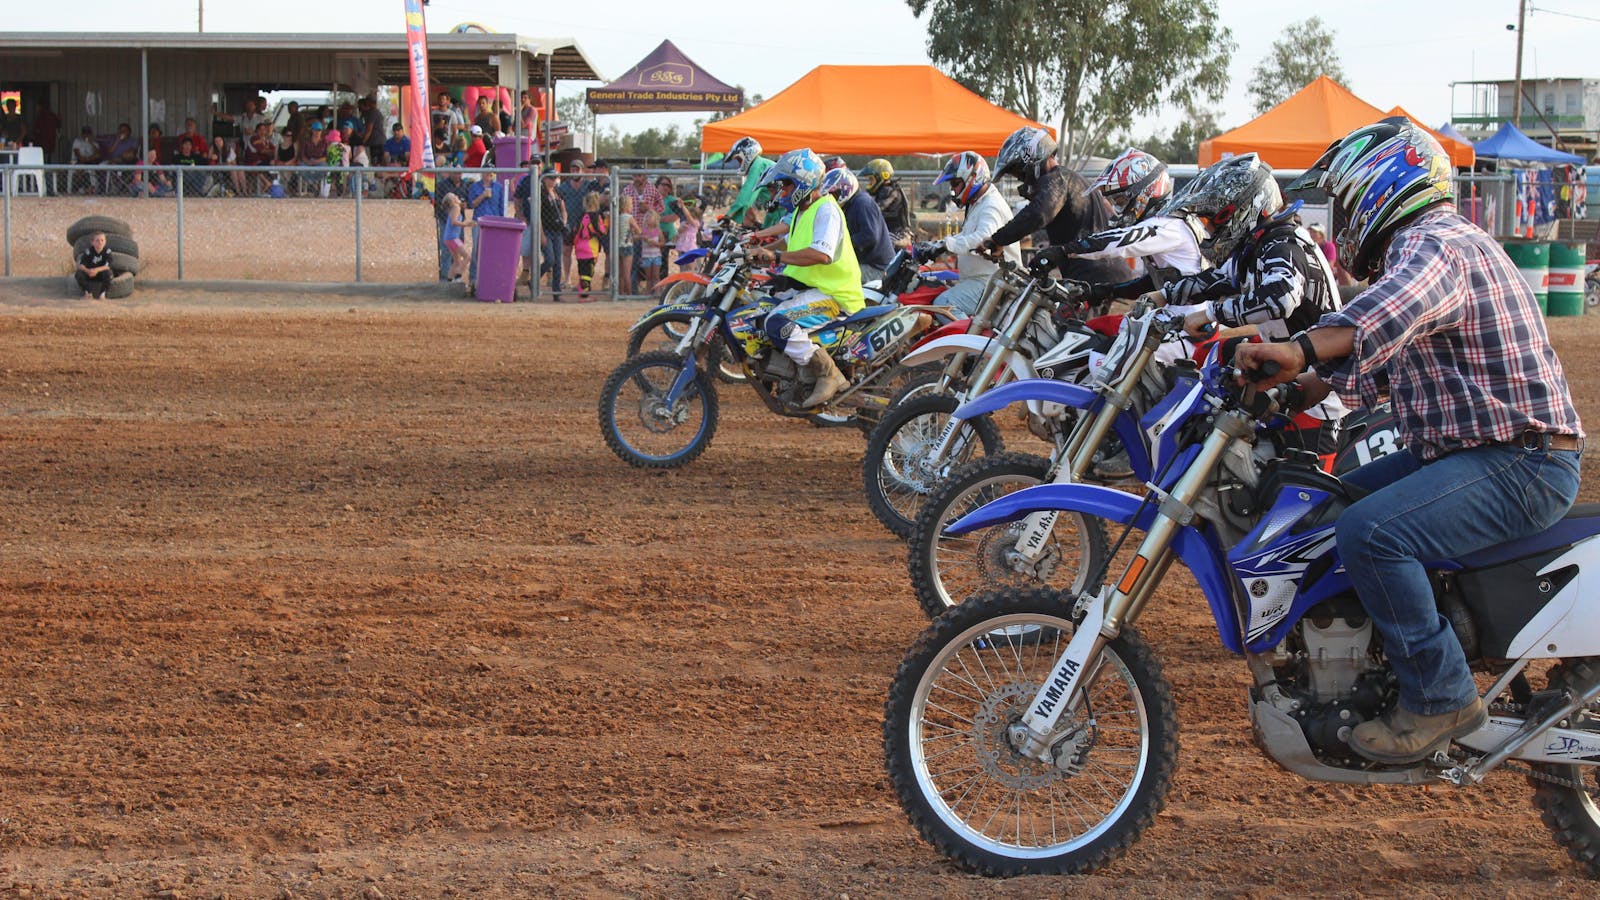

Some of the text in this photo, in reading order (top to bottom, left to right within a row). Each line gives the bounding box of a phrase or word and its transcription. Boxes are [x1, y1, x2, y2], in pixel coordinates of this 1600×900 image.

[590, 91, 625, 99] General
[627, 91, 654, 99] Trade
[656, 92, 703, 100] Industries
[705, 93, 721, 102] Pty
[869, 317, 904, 352] 670
[933, 421, 955, 451] YAMAHA
[1034, 659, 1080, 718] YAMAHA
